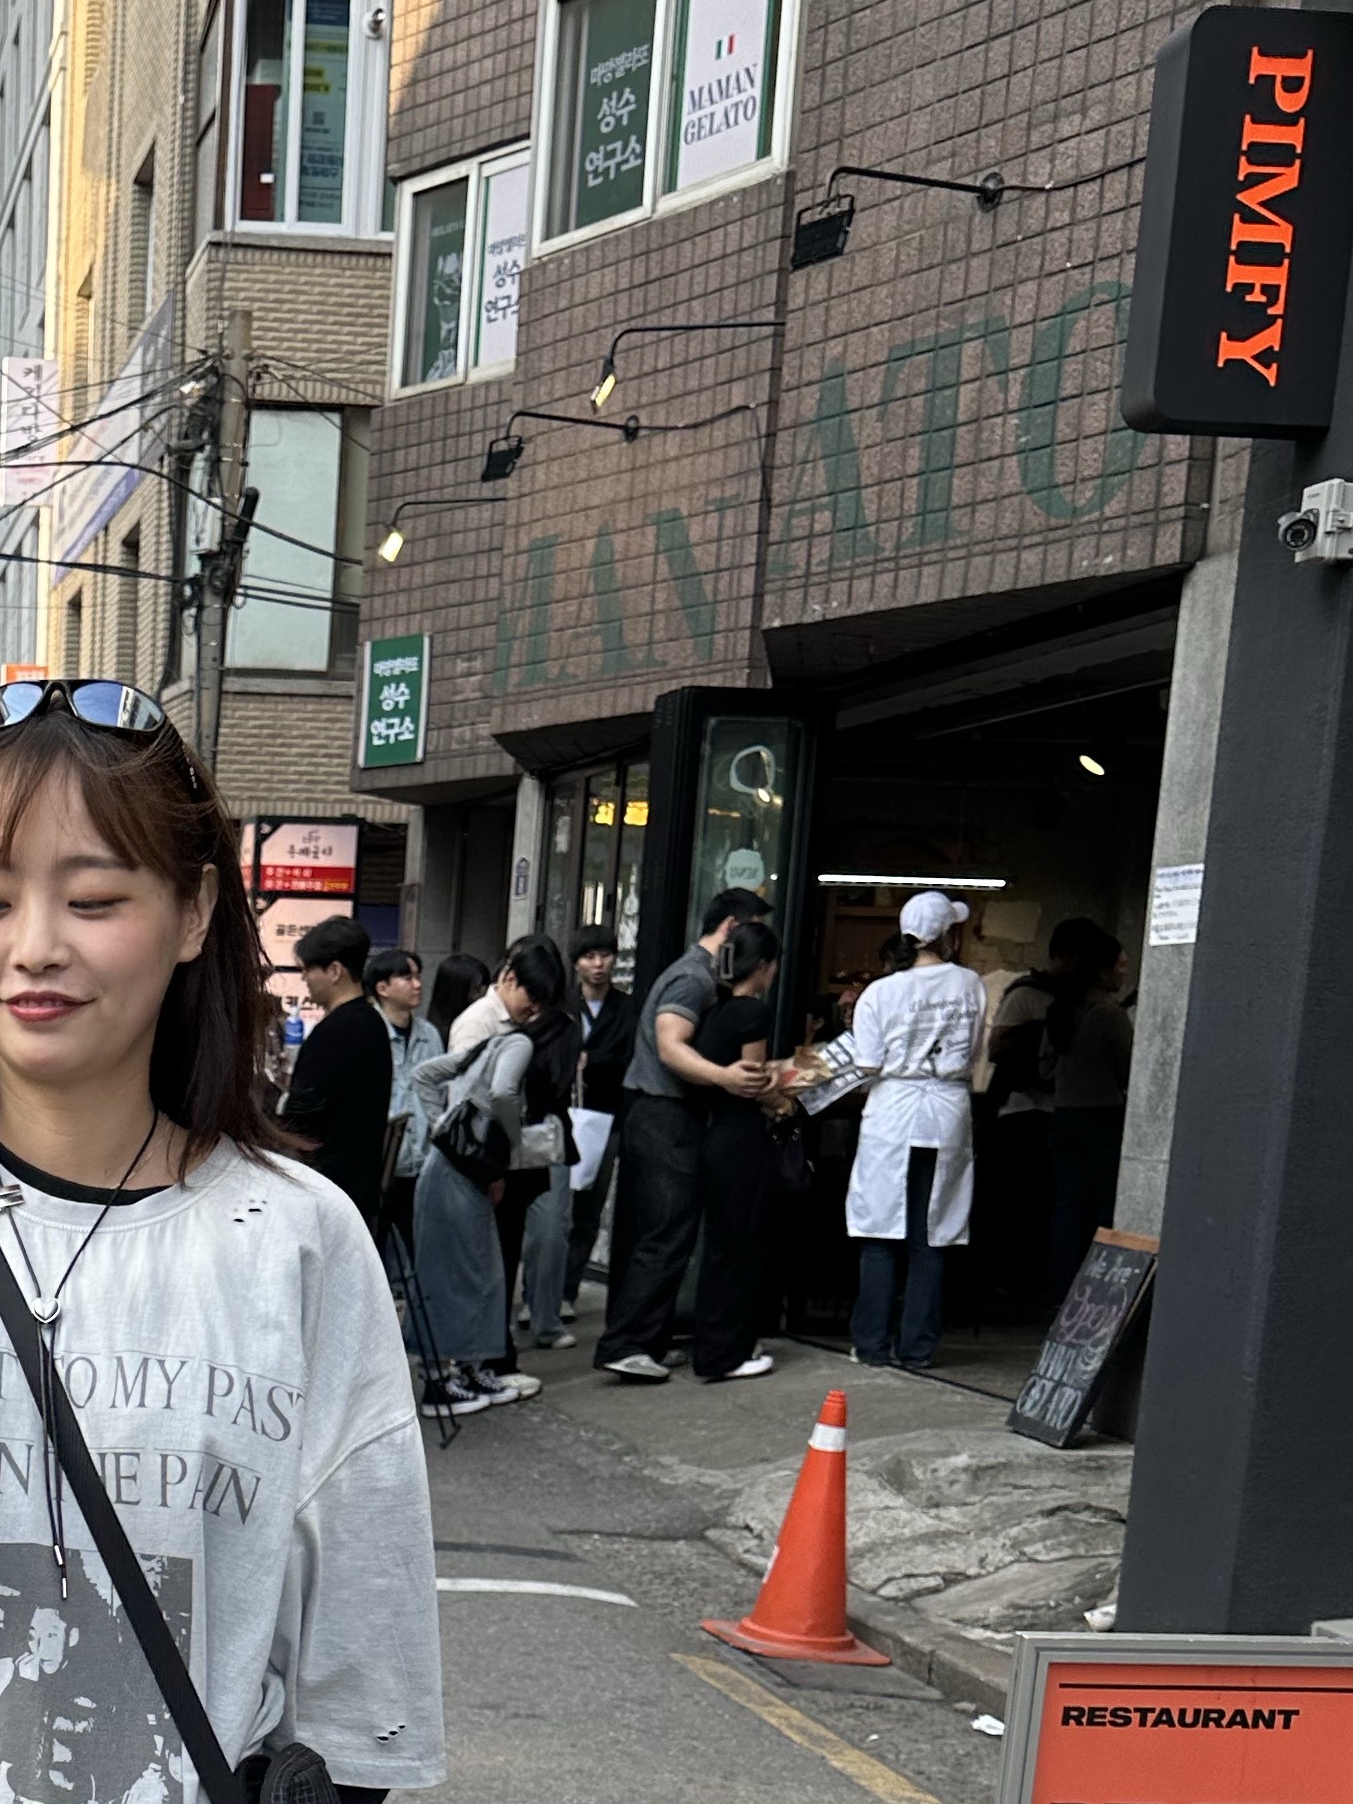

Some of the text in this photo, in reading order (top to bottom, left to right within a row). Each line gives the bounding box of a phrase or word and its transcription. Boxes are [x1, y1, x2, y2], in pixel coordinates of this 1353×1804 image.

[597, 87, 638, 134] 성수
[687, 63, 757, 115] MAMAN
[683, 95, 757, 145] GELATO
[585, 134, 643, 188] 연구소
[1217, 46, 1314, 387] PIMFY
[492, 259, 521, 289] 성수
[379, 682, 411, 711] 성수
[370, 716, 415, 745] 연구소
[108, 1355, 188, 1410] MY
[204, 1364, 305, 1450] PAS
[1060, 1705, 1300, 1730] RESTAURANT
